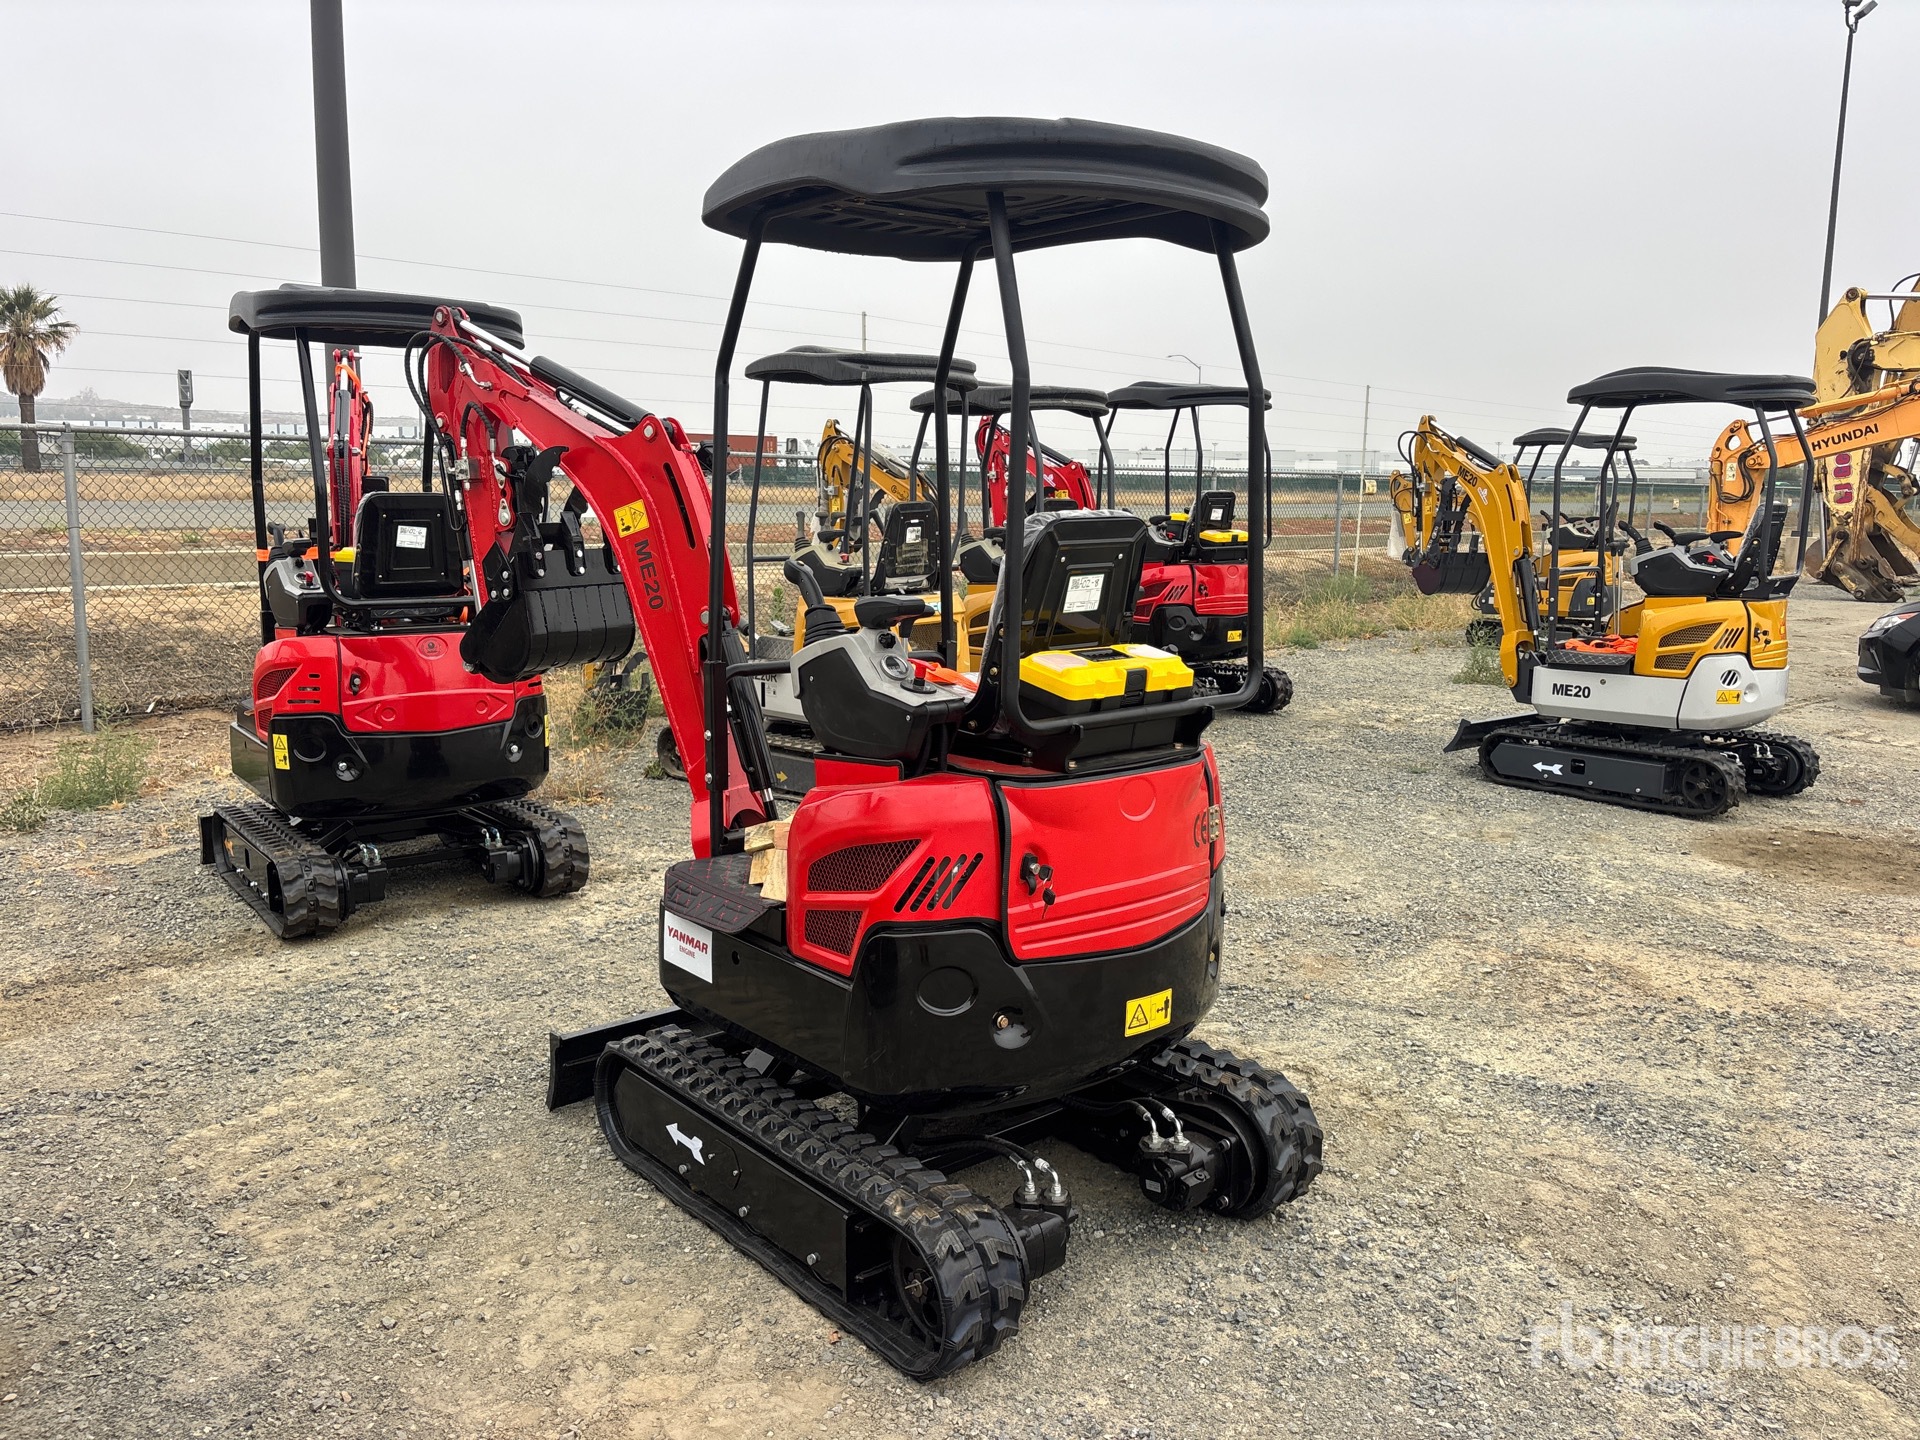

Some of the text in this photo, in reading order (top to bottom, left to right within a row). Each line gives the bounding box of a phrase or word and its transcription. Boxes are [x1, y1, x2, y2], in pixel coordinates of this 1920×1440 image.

[1811, 423, 1879, 451] HYUNDAI
[1457, 465, 1478, 487] ME20
[634, 539, 664, 609] ME20
[1552, 683, 1591, 698] ME20
[667, 925, 708, 955] YANMAR
[679, 944, 696, 959] ENGINE
